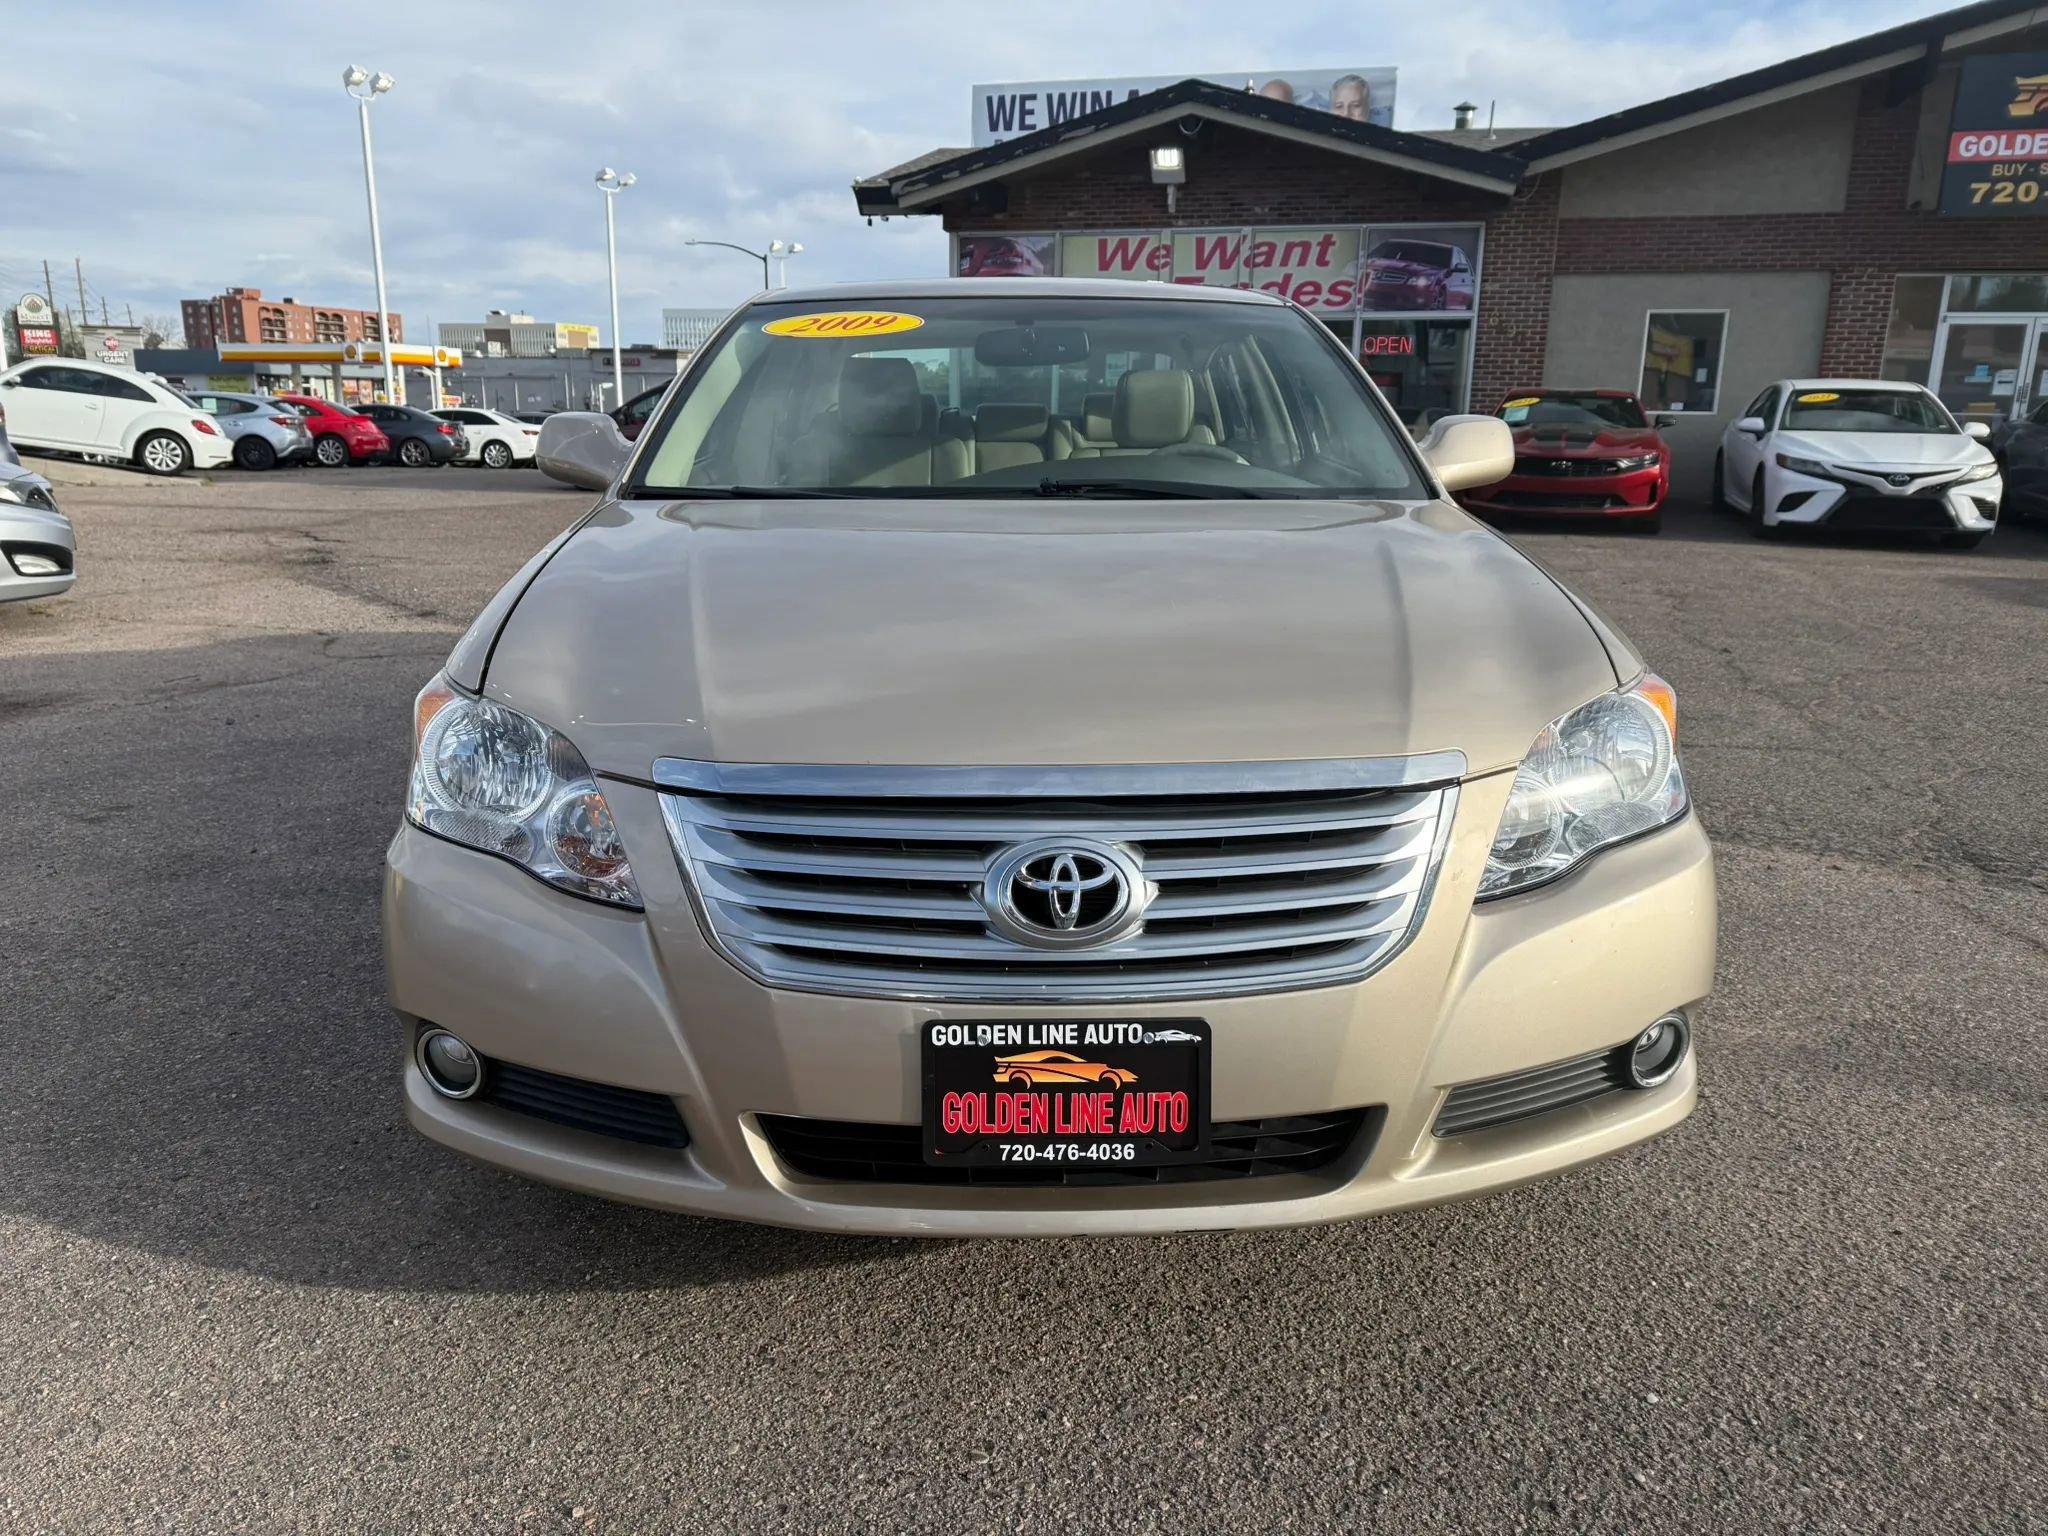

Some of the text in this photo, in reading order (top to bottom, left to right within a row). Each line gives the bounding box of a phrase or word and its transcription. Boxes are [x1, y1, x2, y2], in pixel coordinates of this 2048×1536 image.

[986, 93, 1037, 132] WE
[1991, 163, 2028, 176] BUY
[1097, 233, 1336, 271] We Want
[786, 315, 898, 332] 2009
[23, 328, 52, 338] KING
[96, 350, 129, 358] URGENT
[1363, 336, 1413, 354] OPEN
[931, 1023, 1143, 1046] GOLDEN LINE AUTO
[942, 1091, 1189, 1134] GOLDEN LINE AUTO
[1000, 1143, 1136, 1161] 720-476-4036
